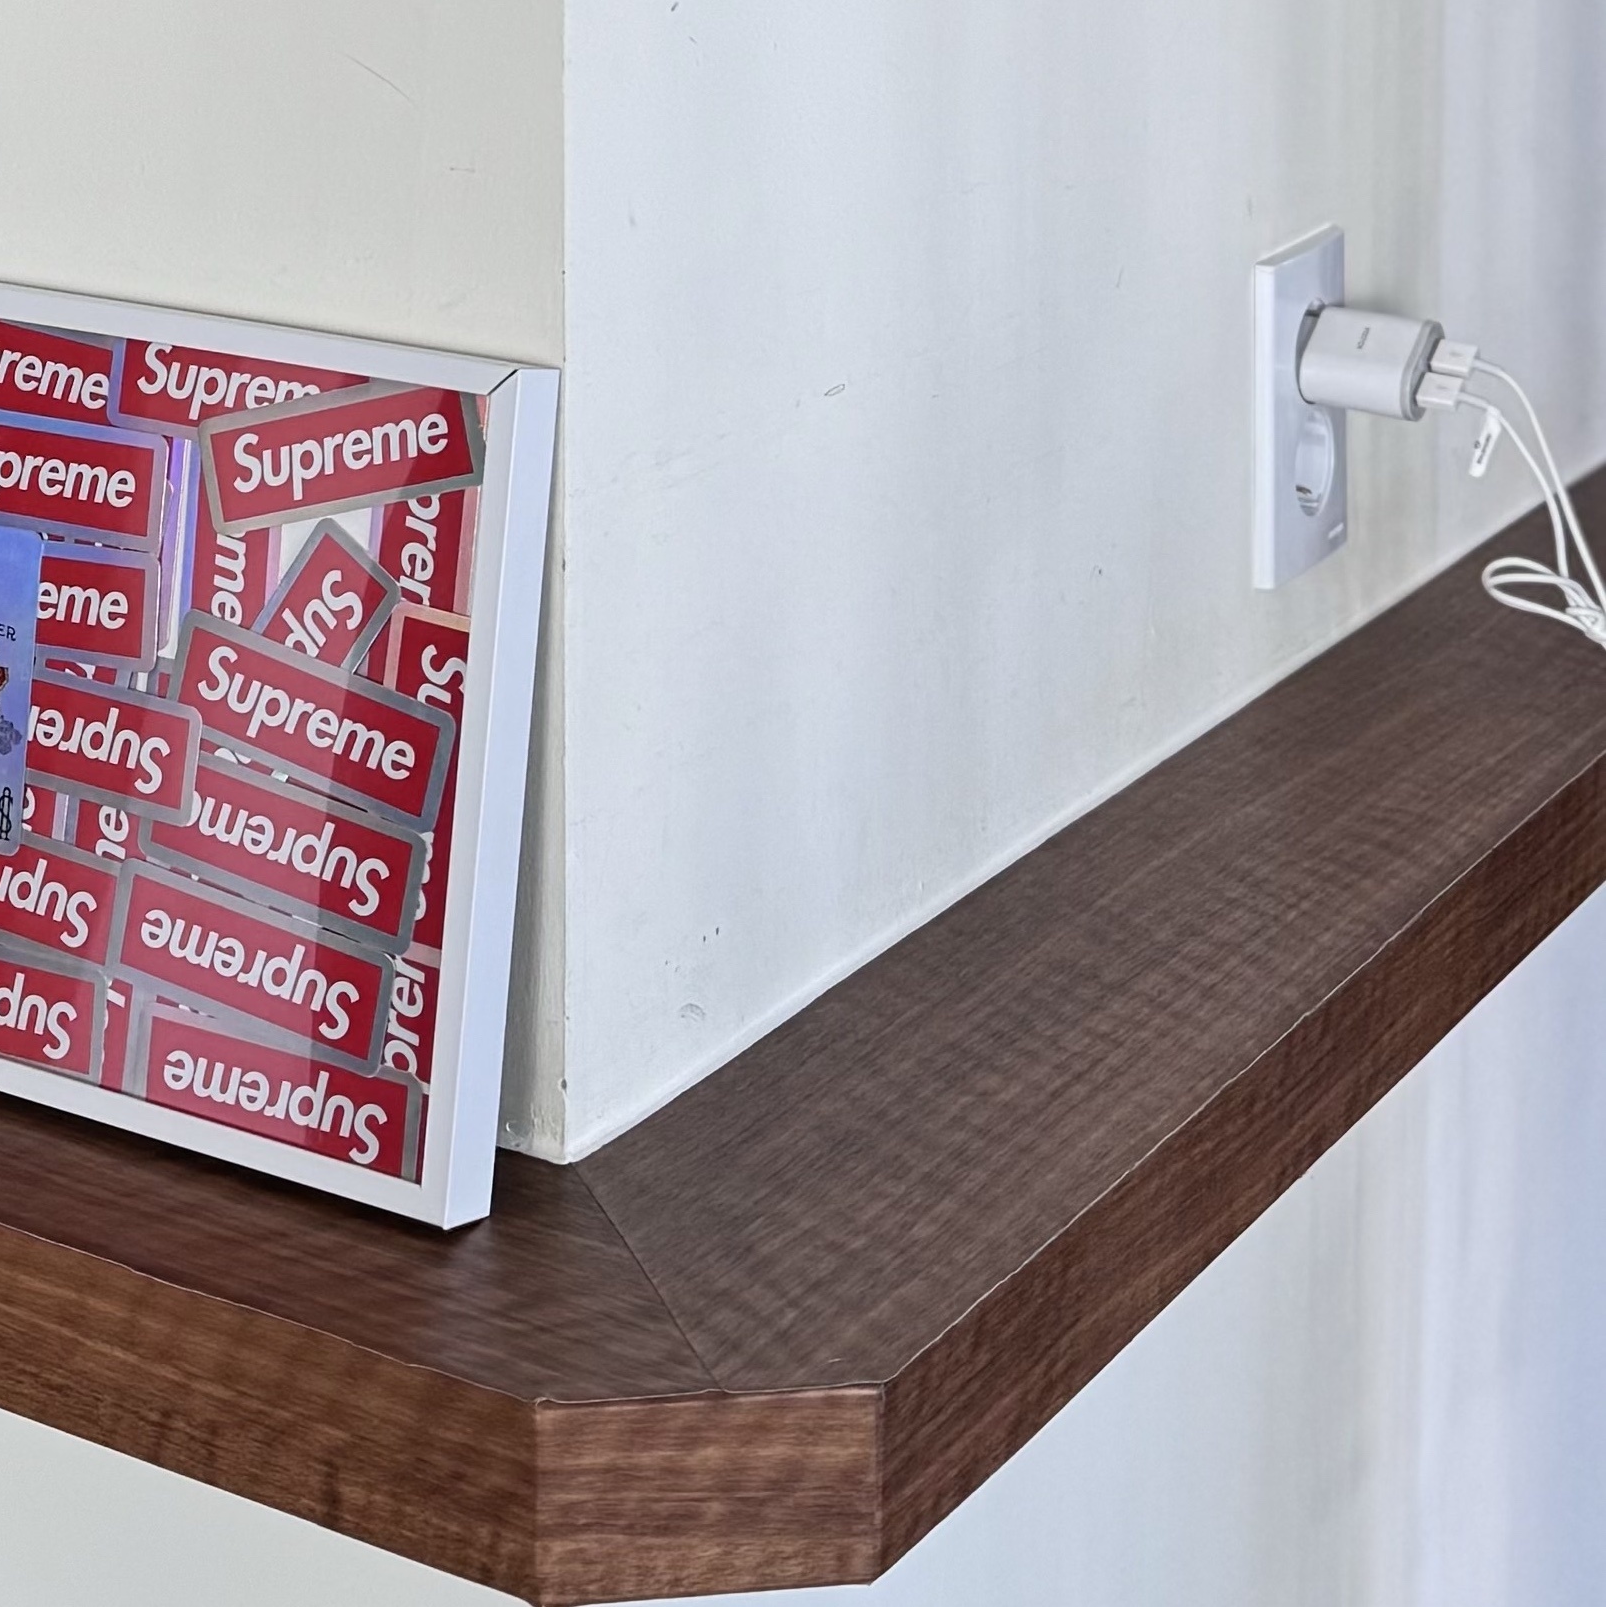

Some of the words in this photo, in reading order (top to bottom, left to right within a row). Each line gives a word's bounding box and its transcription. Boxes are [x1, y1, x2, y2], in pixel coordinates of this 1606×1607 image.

[233, 413, 448, 500] Supreme
[198, 646, 416, 779] Supreme
[141, 909, 360, 1040] Supreme
[163, 1049, 388, 1164] Supreme
